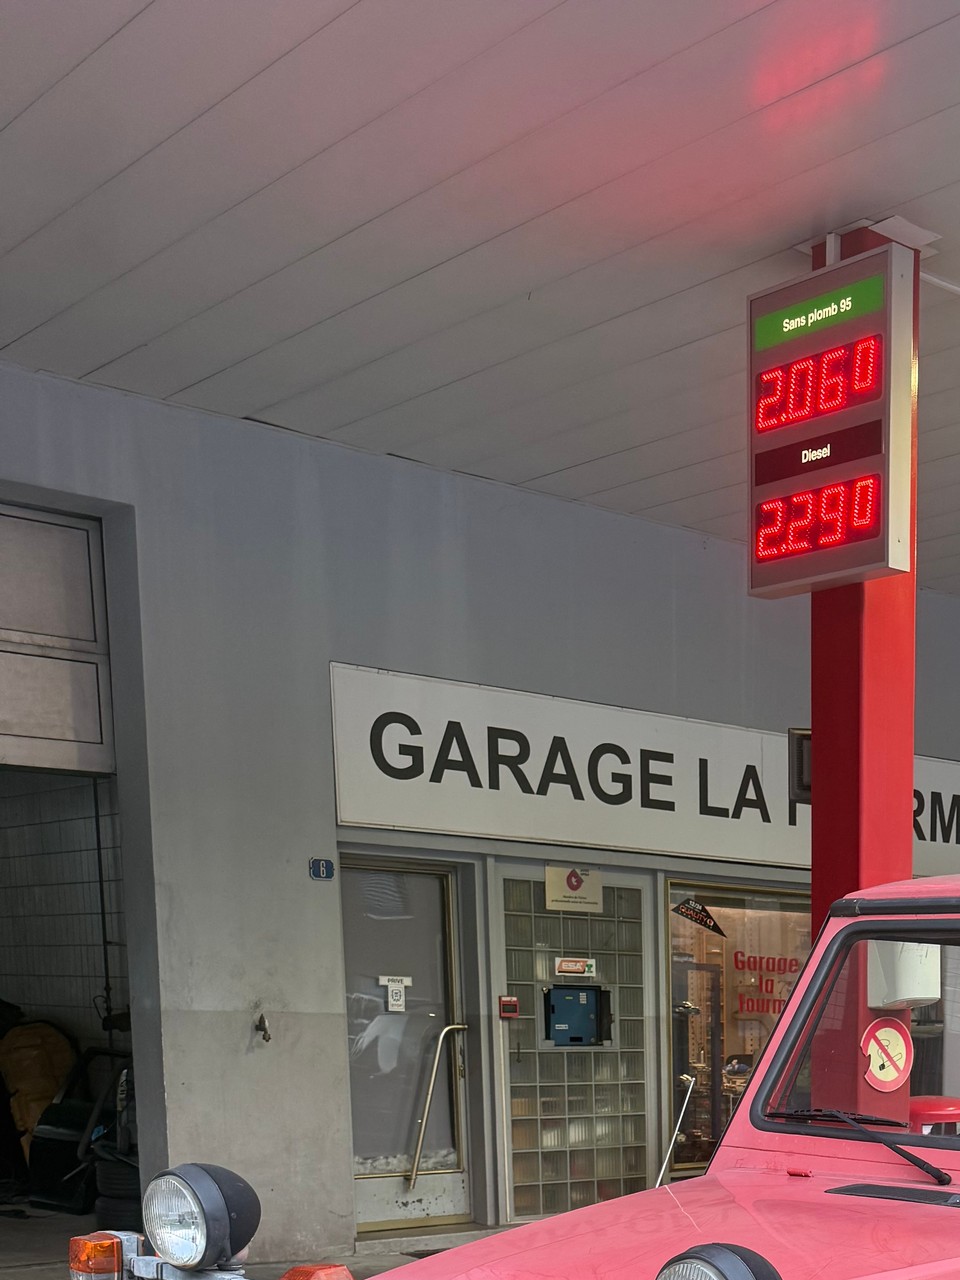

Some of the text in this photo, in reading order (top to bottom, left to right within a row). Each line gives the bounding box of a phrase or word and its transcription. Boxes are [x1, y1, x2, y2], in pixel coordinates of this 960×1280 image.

[782, 296, 852, 333] Sans plomb 95
[801, 443, 831, 464] Diesel
[369, 711, 676, 812] GARAGE
[698, 757, 772, 824] LA
[320, 860, 326, 878] 6
[733, 950, 799, 975] Garage
[758, 974, 774, 994] la
[738, 993, 787, 1015] Fourm
